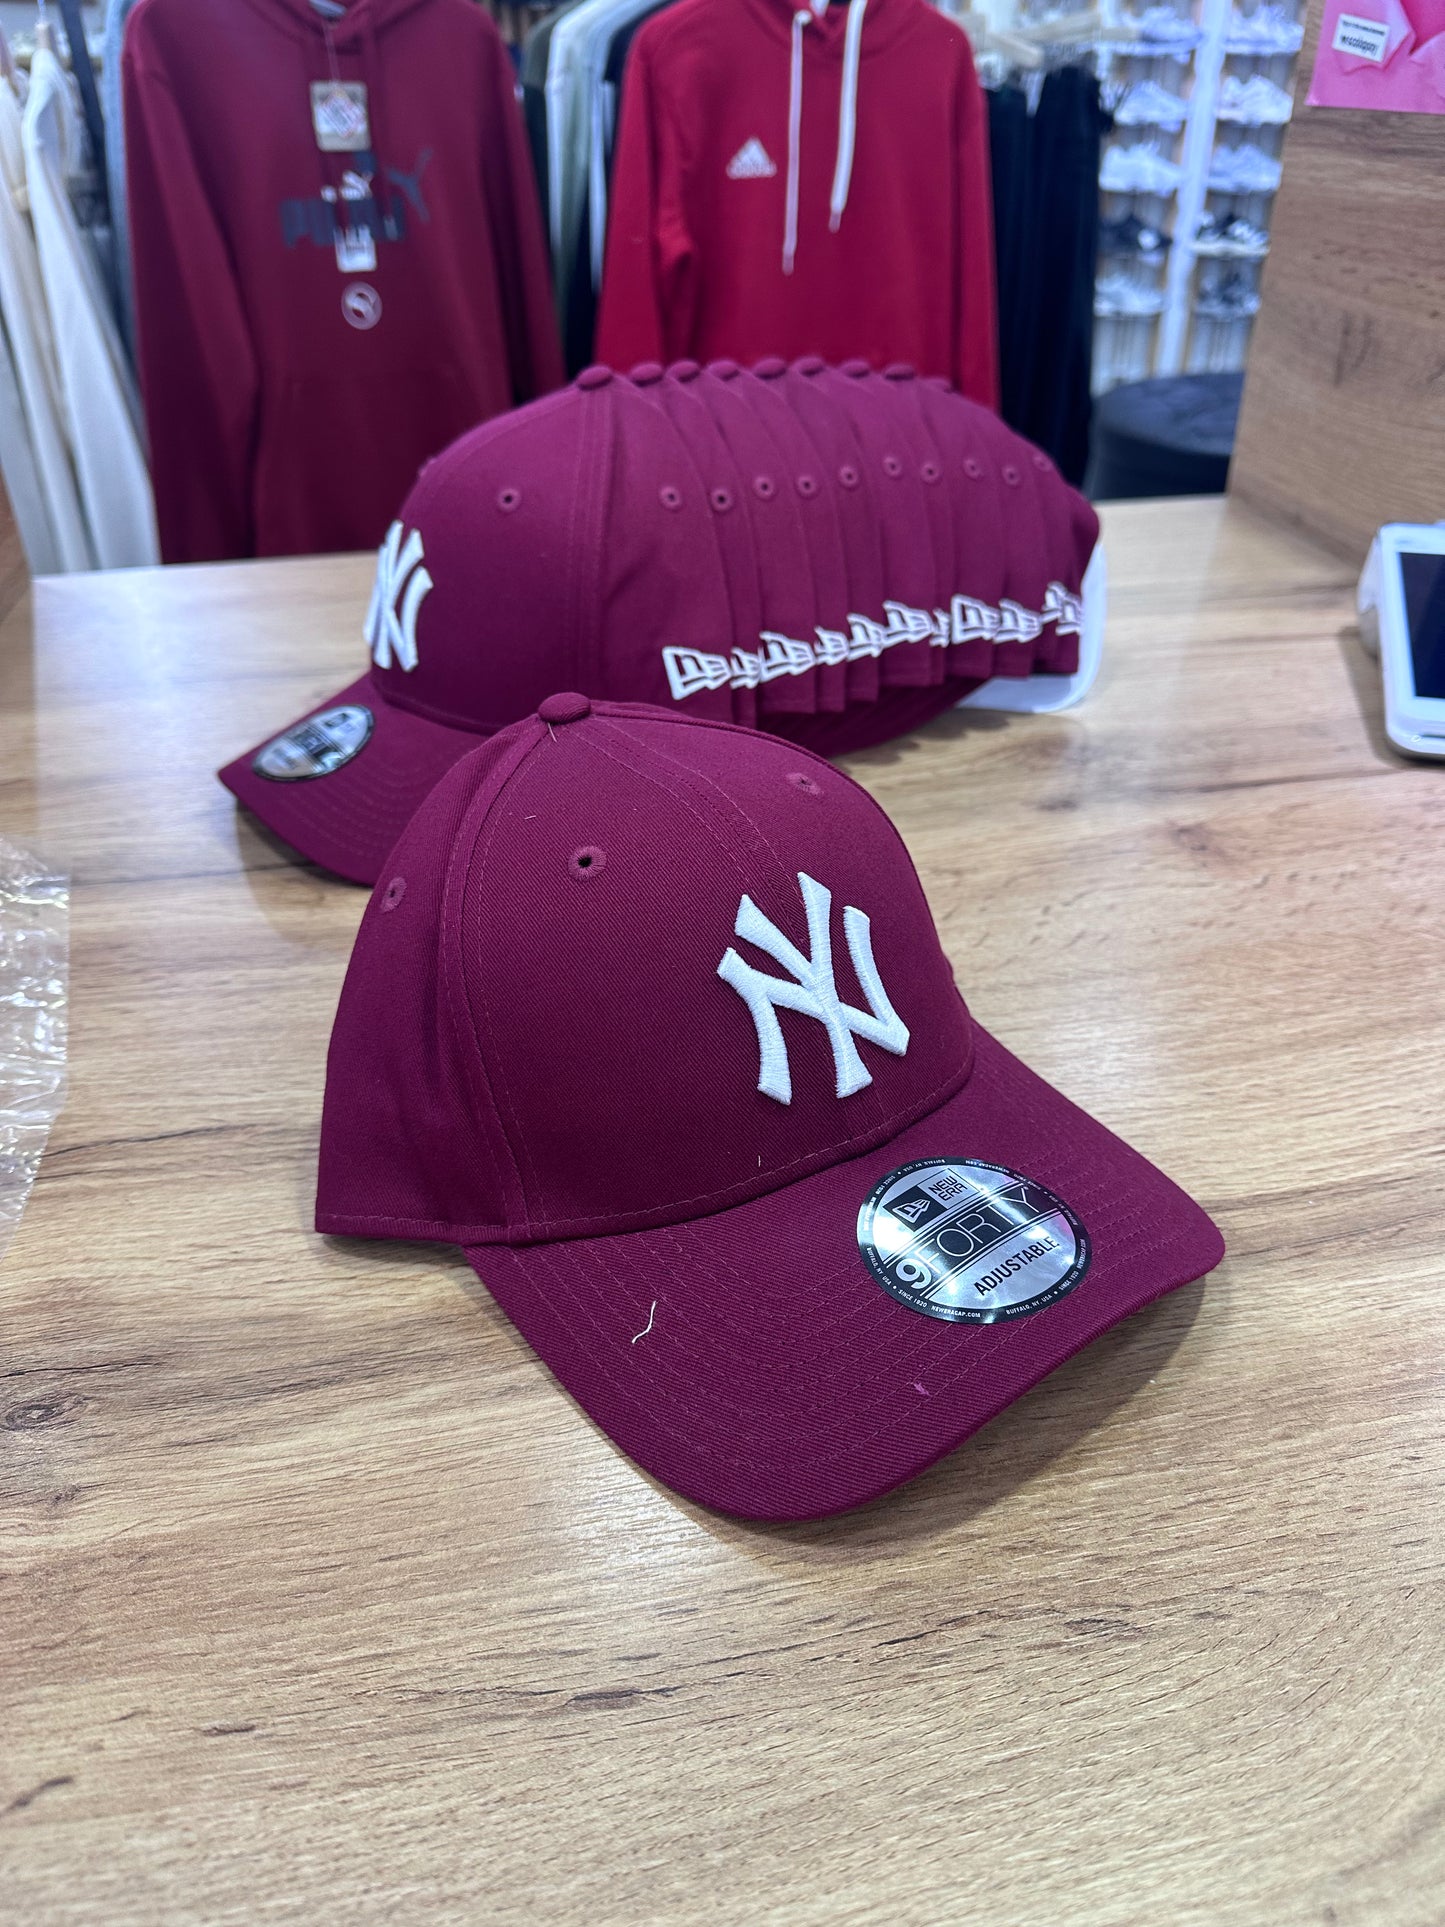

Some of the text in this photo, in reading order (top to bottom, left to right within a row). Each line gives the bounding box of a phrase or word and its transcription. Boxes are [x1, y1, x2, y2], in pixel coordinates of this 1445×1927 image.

[716, 871, 910, 1105] NY
[928, 1175, 957, 1195] NEW
[938, 1183, 968, 1202] ERA
[974, 1236, 1060, 1296] ADJUSTABLE
[898, 1289, 914, 1301] SINCE
[914, 1298, 928, 1308] 1920
[931, 1305, 981, 1318] NEWERACAP.COM
